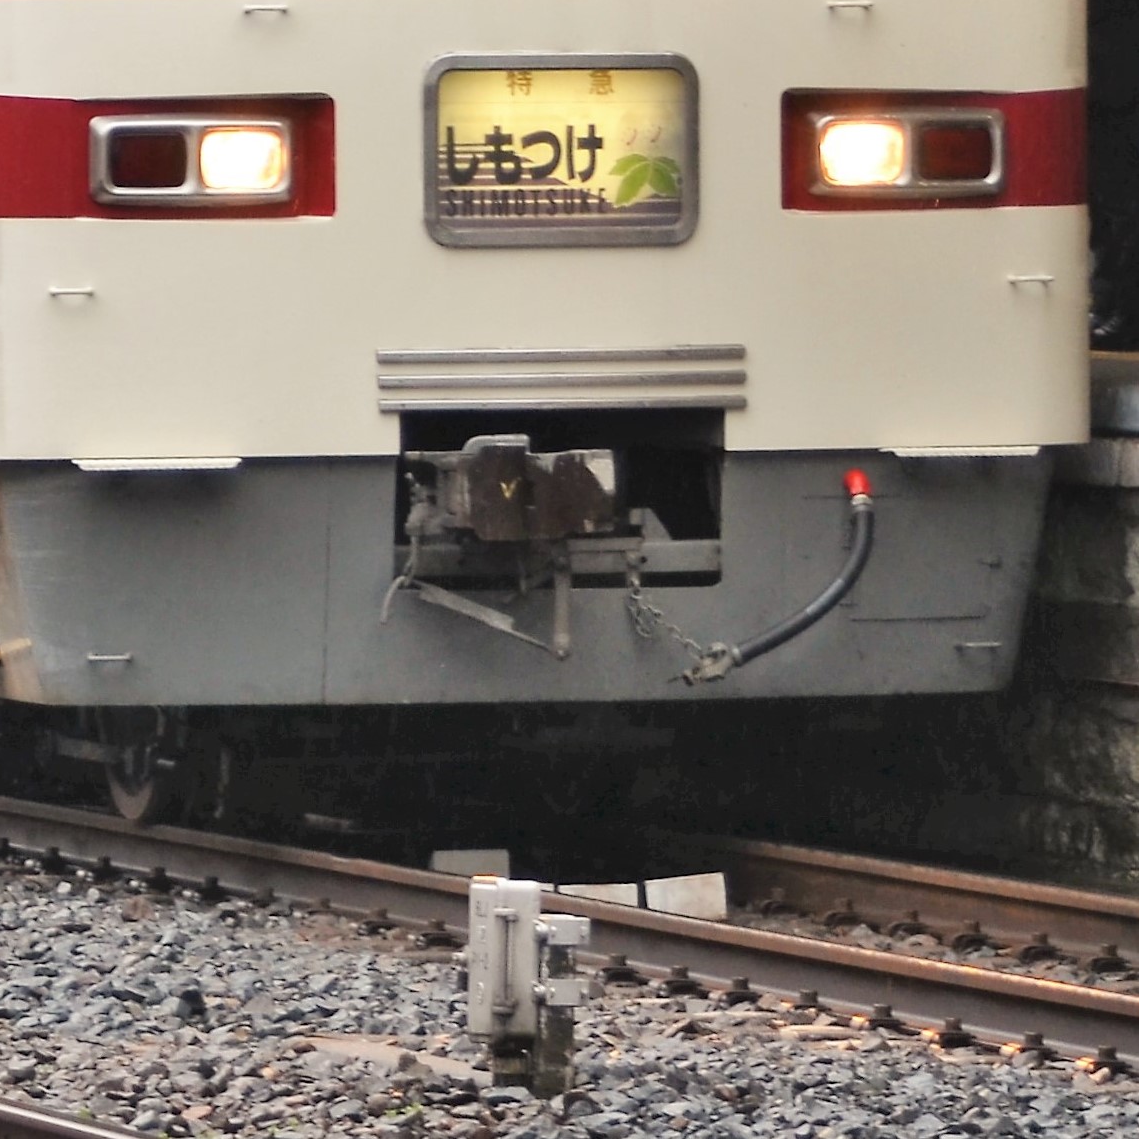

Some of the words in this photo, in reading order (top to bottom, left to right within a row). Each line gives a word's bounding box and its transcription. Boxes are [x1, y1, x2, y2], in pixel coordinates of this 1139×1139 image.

[506, 69, 615, 96] 特急
[446, 124, 603, 185] しもつけ
[445, 187, 607, 217] SHIMOTSUKE
